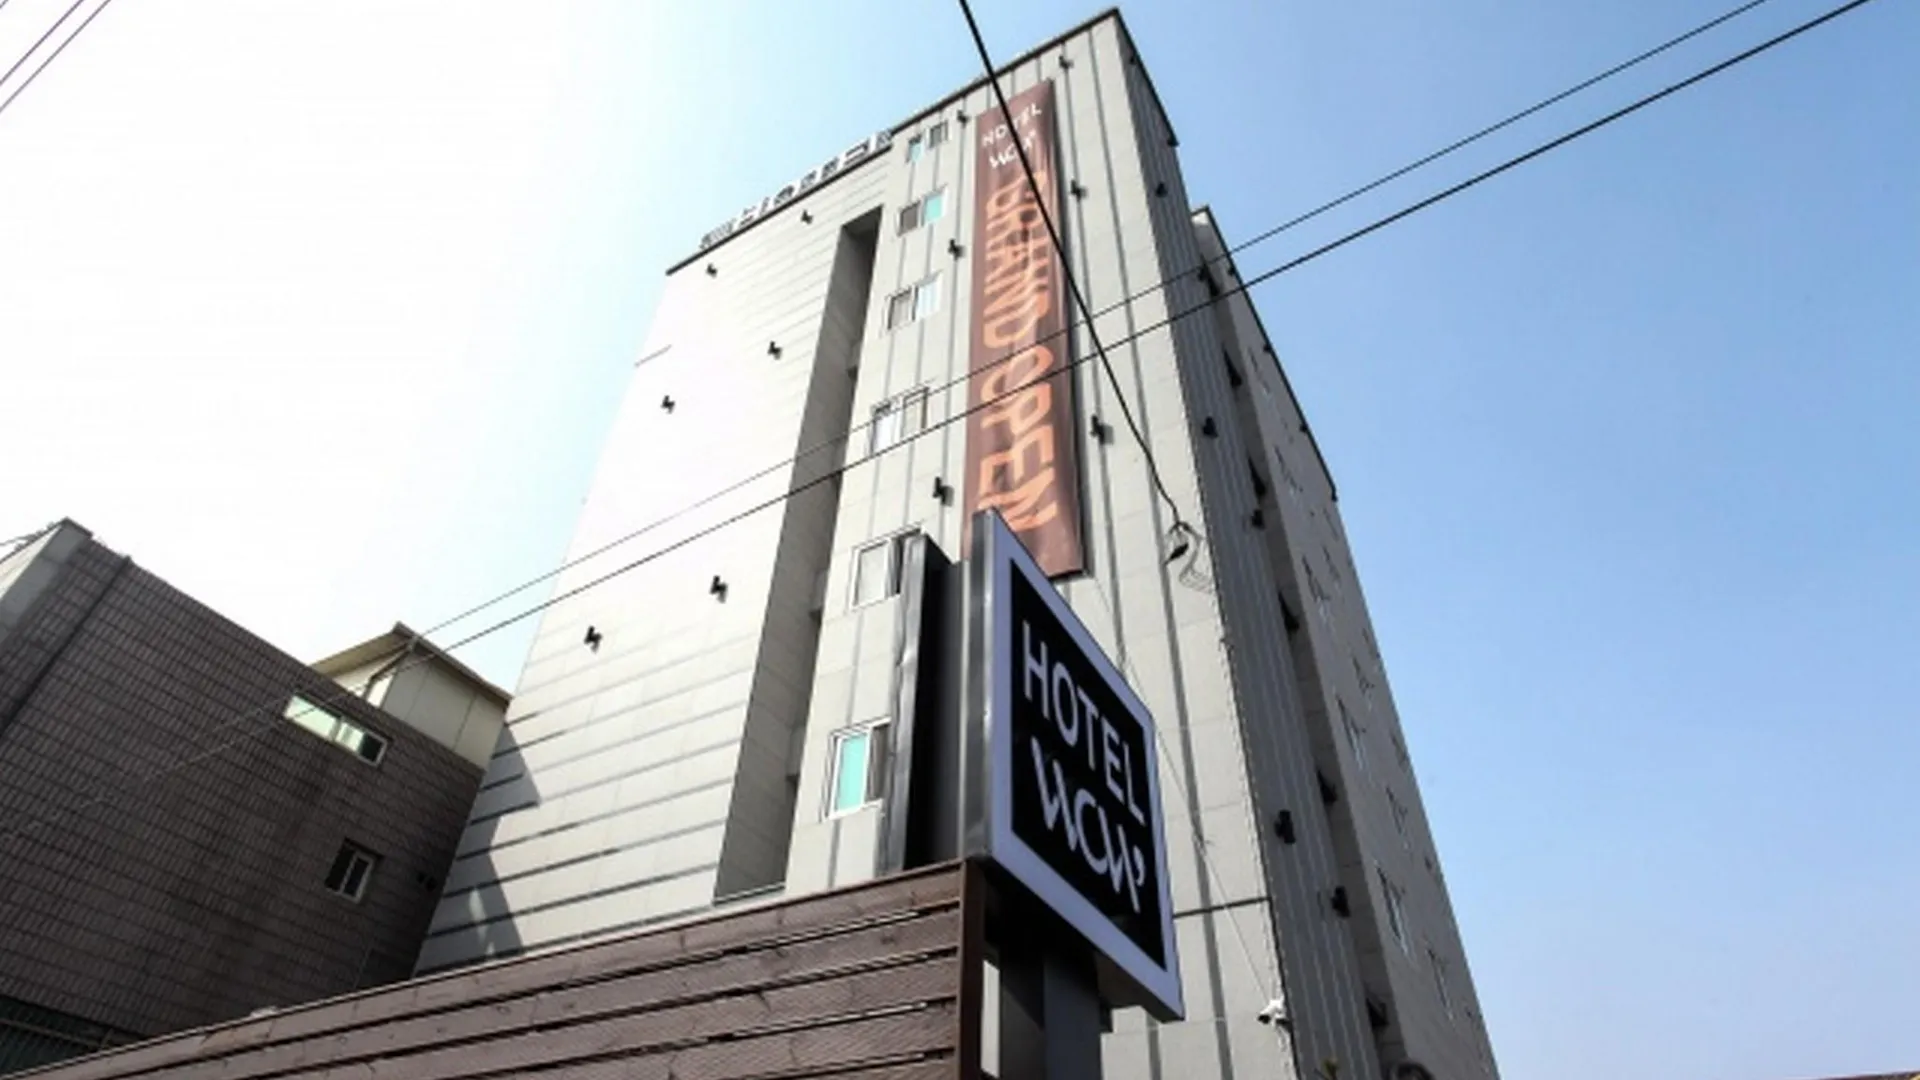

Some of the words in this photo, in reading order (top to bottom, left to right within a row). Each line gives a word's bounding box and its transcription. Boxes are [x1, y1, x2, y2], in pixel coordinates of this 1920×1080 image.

[983, 171, 1049, 348] GRAND
[978, 345, 1058, 531] OPEN
[1023, 619, 1146, 827] HOTEL
